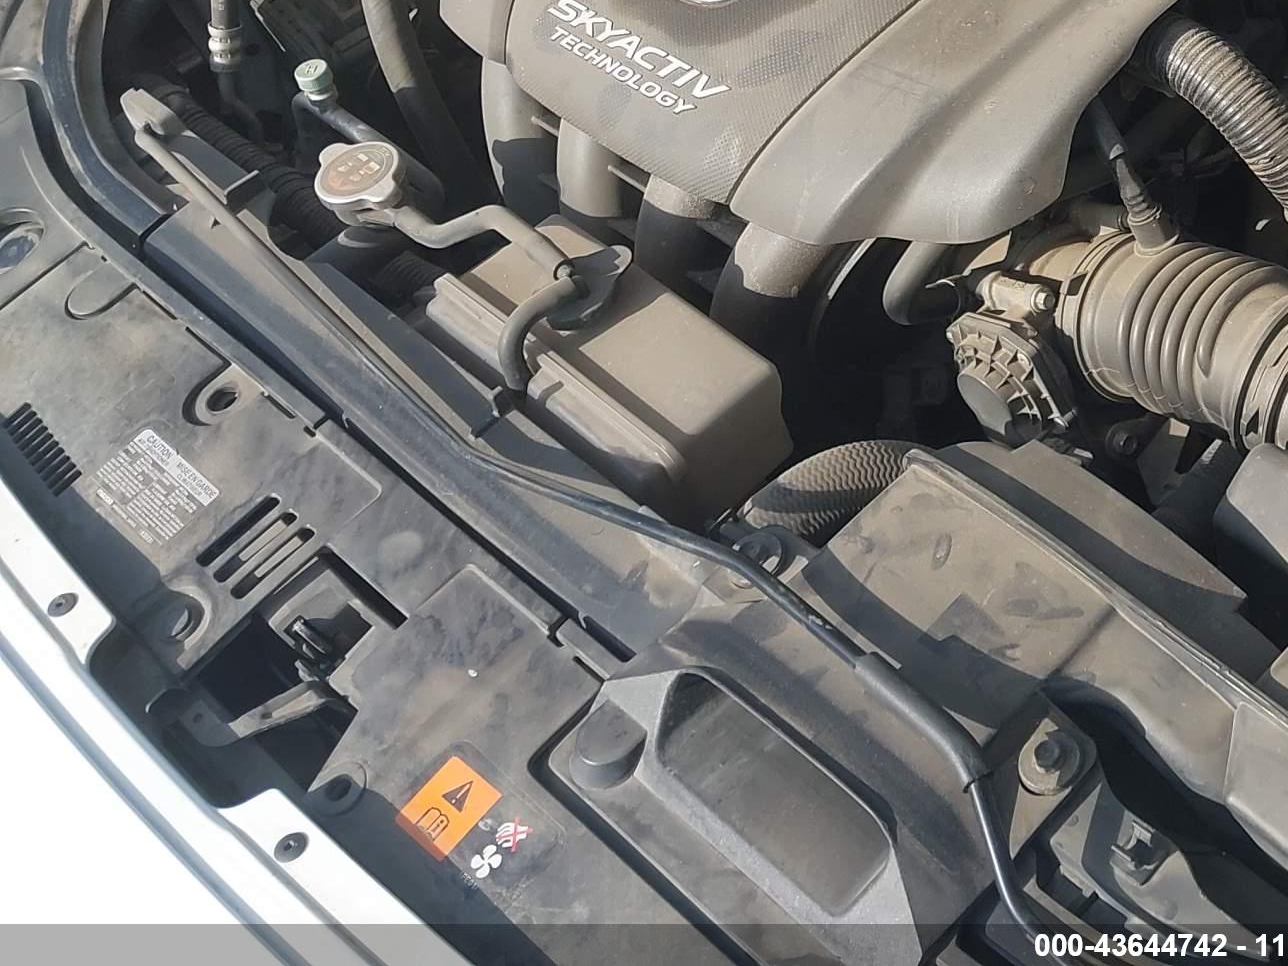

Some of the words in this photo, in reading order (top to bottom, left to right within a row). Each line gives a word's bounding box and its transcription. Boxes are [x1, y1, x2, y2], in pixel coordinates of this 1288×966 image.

[550, 26, 697, 115] TECHNOLOGY
[146, 434, 174, 459] CAUTION
[194, 478, 216, 499] GARDE
